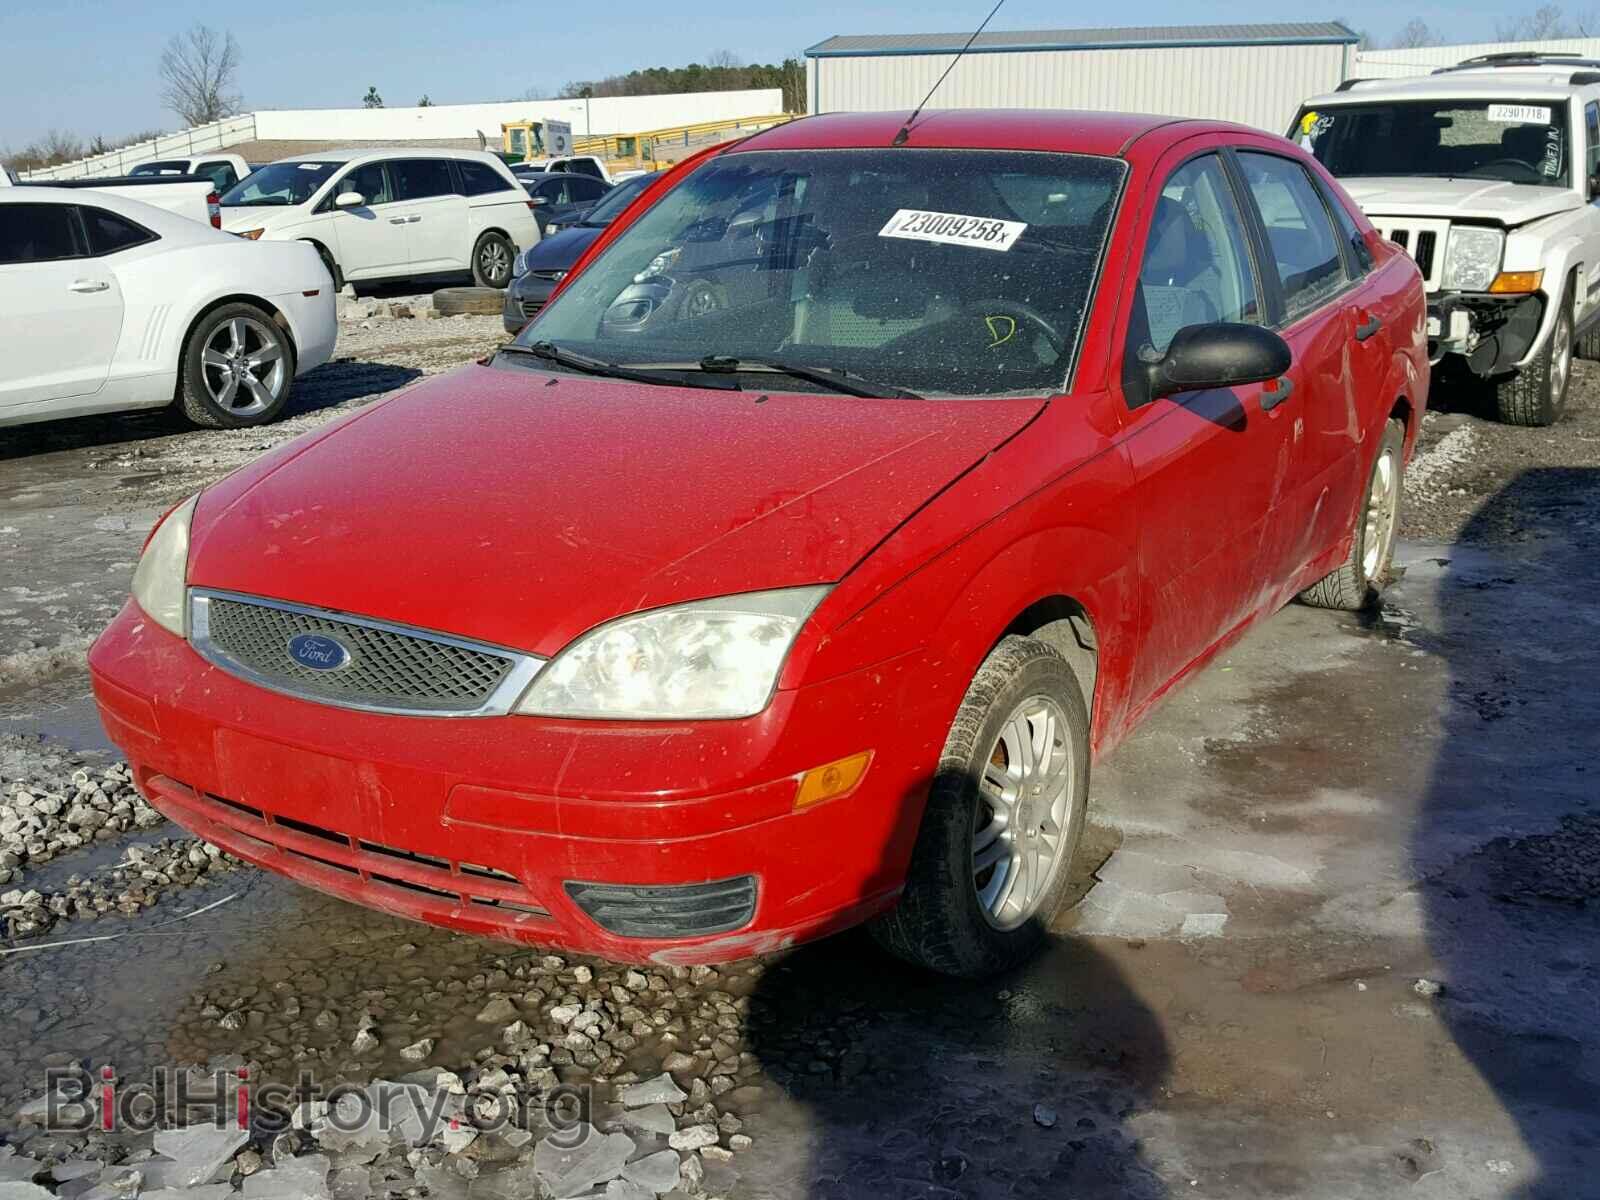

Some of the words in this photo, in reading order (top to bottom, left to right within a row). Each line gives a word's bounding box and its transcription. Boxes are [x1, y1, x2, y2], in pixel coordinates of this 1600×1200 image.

[1543, 142, 1559, 176] TOWED
[986, 316, 1015, 349] D
[300, 640, 334, 662] Ford
